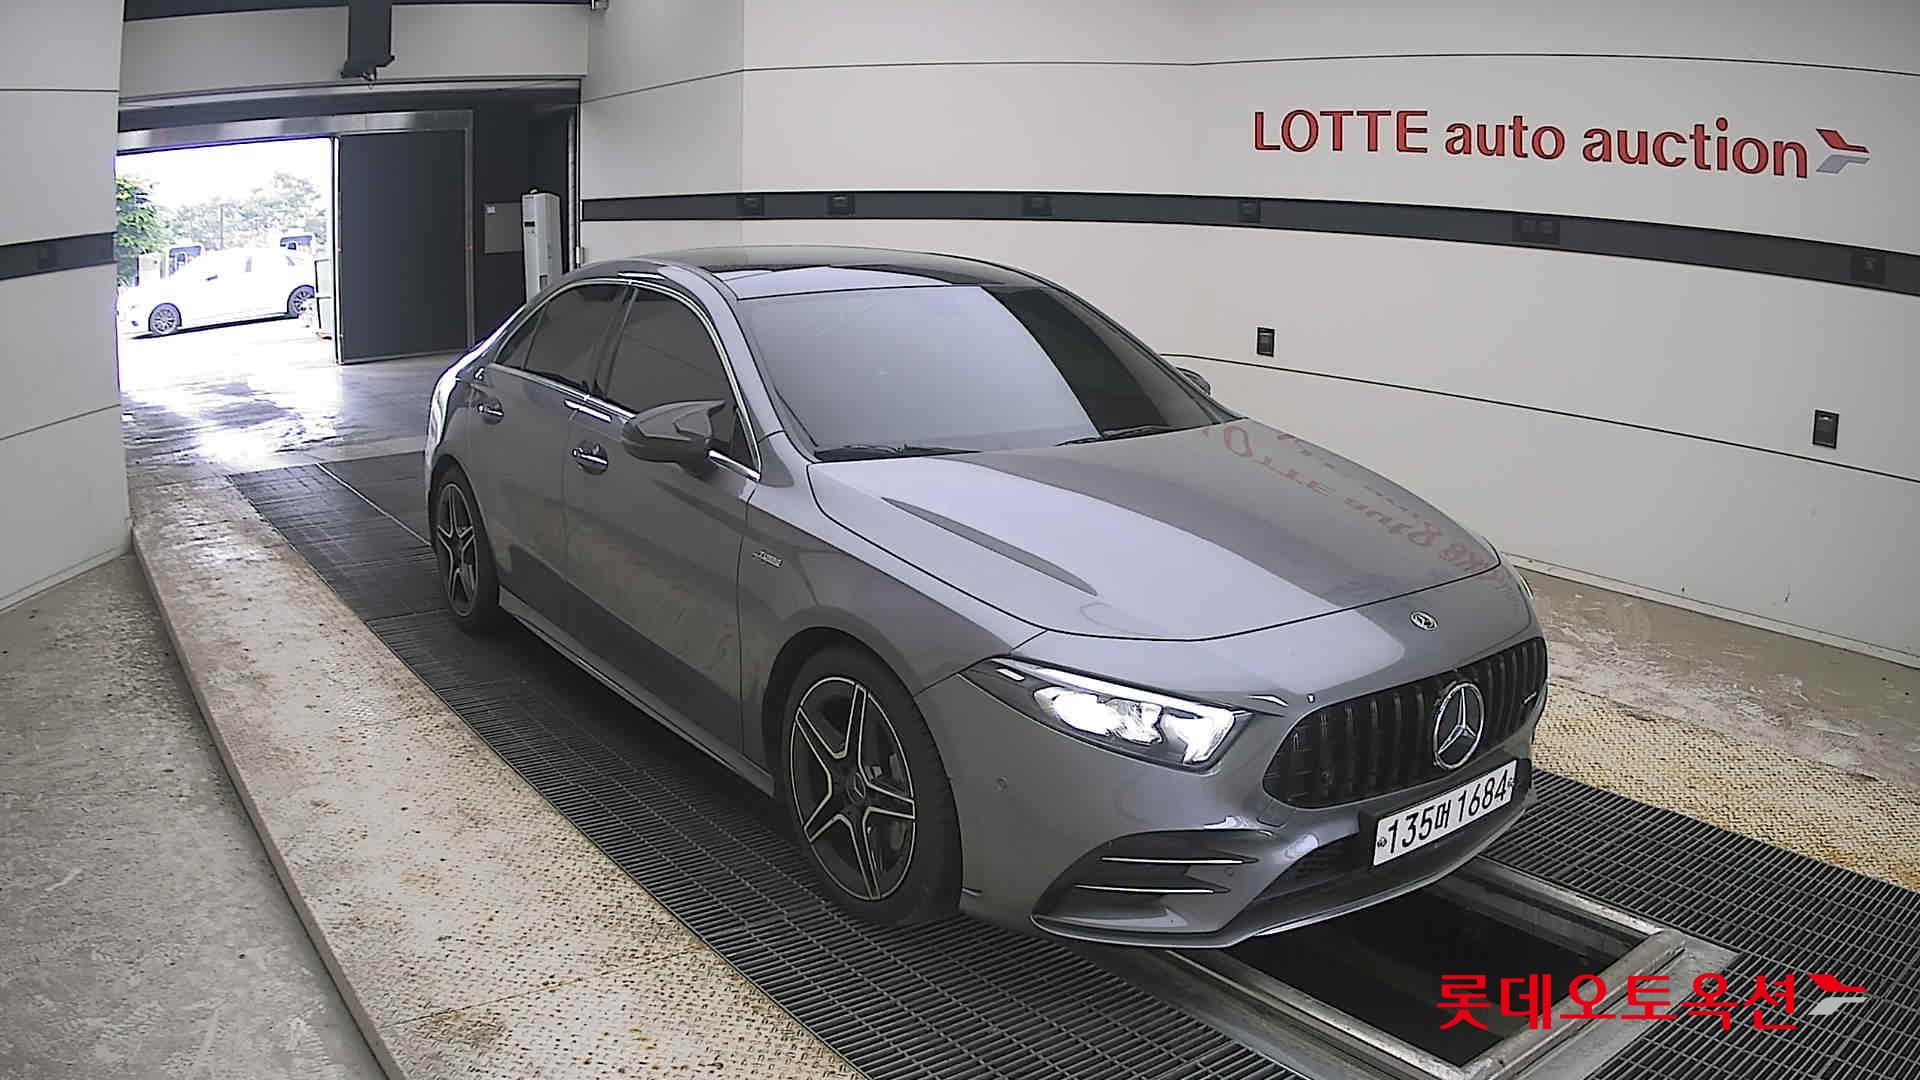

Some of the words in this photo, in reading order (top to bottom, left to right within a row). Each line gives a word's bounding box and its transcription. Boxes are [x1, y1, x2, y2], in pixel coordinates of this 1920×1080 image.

[1253, 110, 1429, 154] LOTTE
[1444, 116, 1567, 162] auto
[1583, 117, 1809, 178] auction
[1457, 769, 1508, 823] 1684
